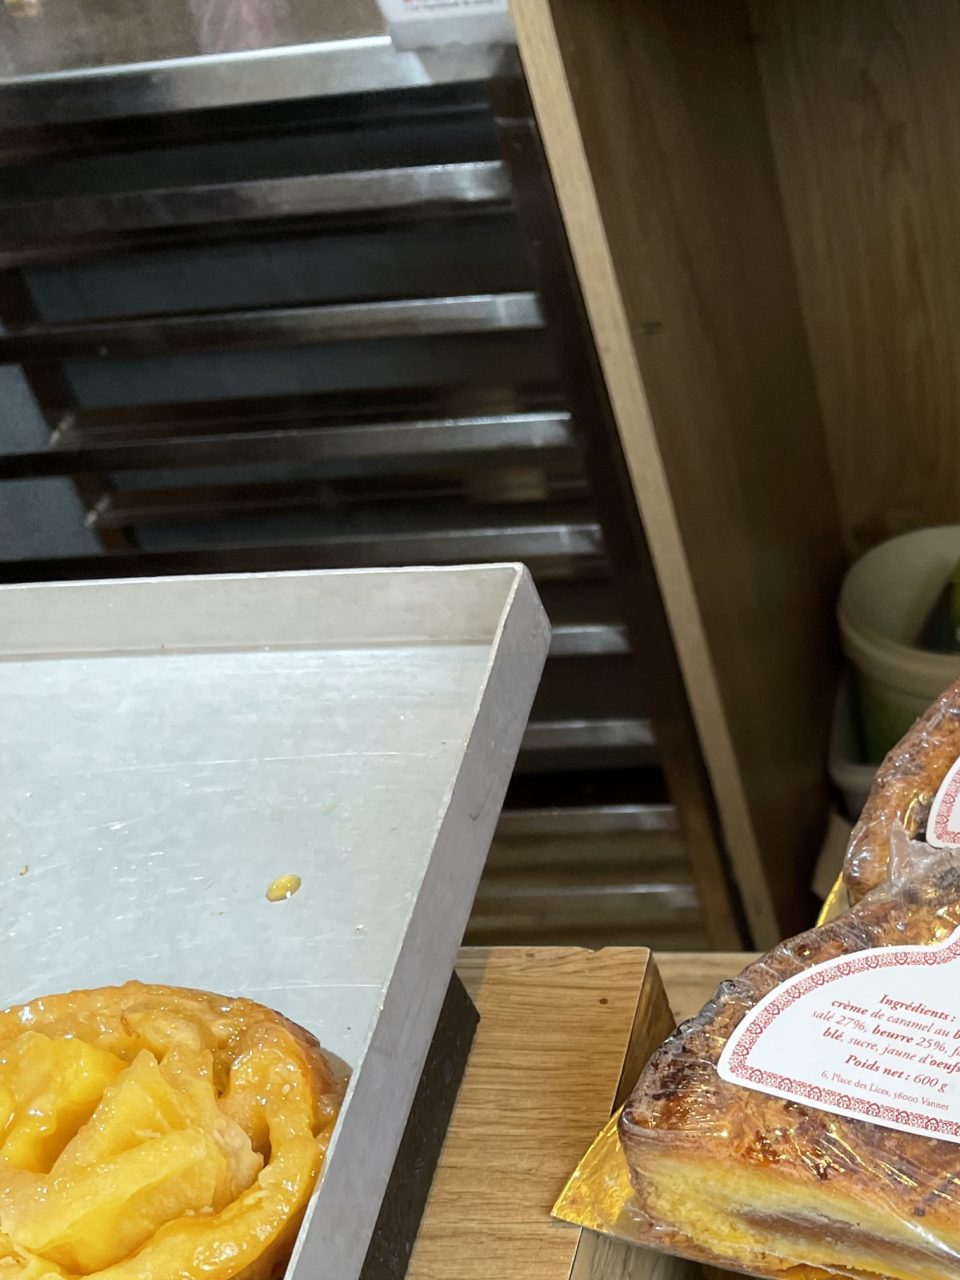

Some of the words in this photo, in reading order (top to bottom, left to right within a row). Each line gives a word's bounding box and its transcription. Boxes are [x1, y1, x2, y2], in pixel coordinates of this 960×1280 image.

[811, 1009, 833, 1022] salé
[835, 1016, 867, 1032] 27%,
[872, 1025, 914, 1044] beurre
[916, 1037, 948, 1054] 25%,
[831, 999, 868, 1016] crème
[871, 1008, 885, 1020] de
[887, 1015, 934, 1033] caramel
[936, 1026, 950, 1038] au
[823, 1027, 843, 1042] blé,
[848, 1036, 879, 1052] sucre,
[881, 1046, 916, 1062] jaune
[821, 1071, 829, 1080] 6,
[831, 1073, 852, 1086] Place
[854, 1079, 867, 1089] des
[870, 1083, 891, 1097] Lices,
[893, 1093, 919, 1103] 56000
[921, 1097, 949, 1110] Vannes
[845, 1054, 881, 1073] Poids
[914, 1074, 938, 1088] 600
